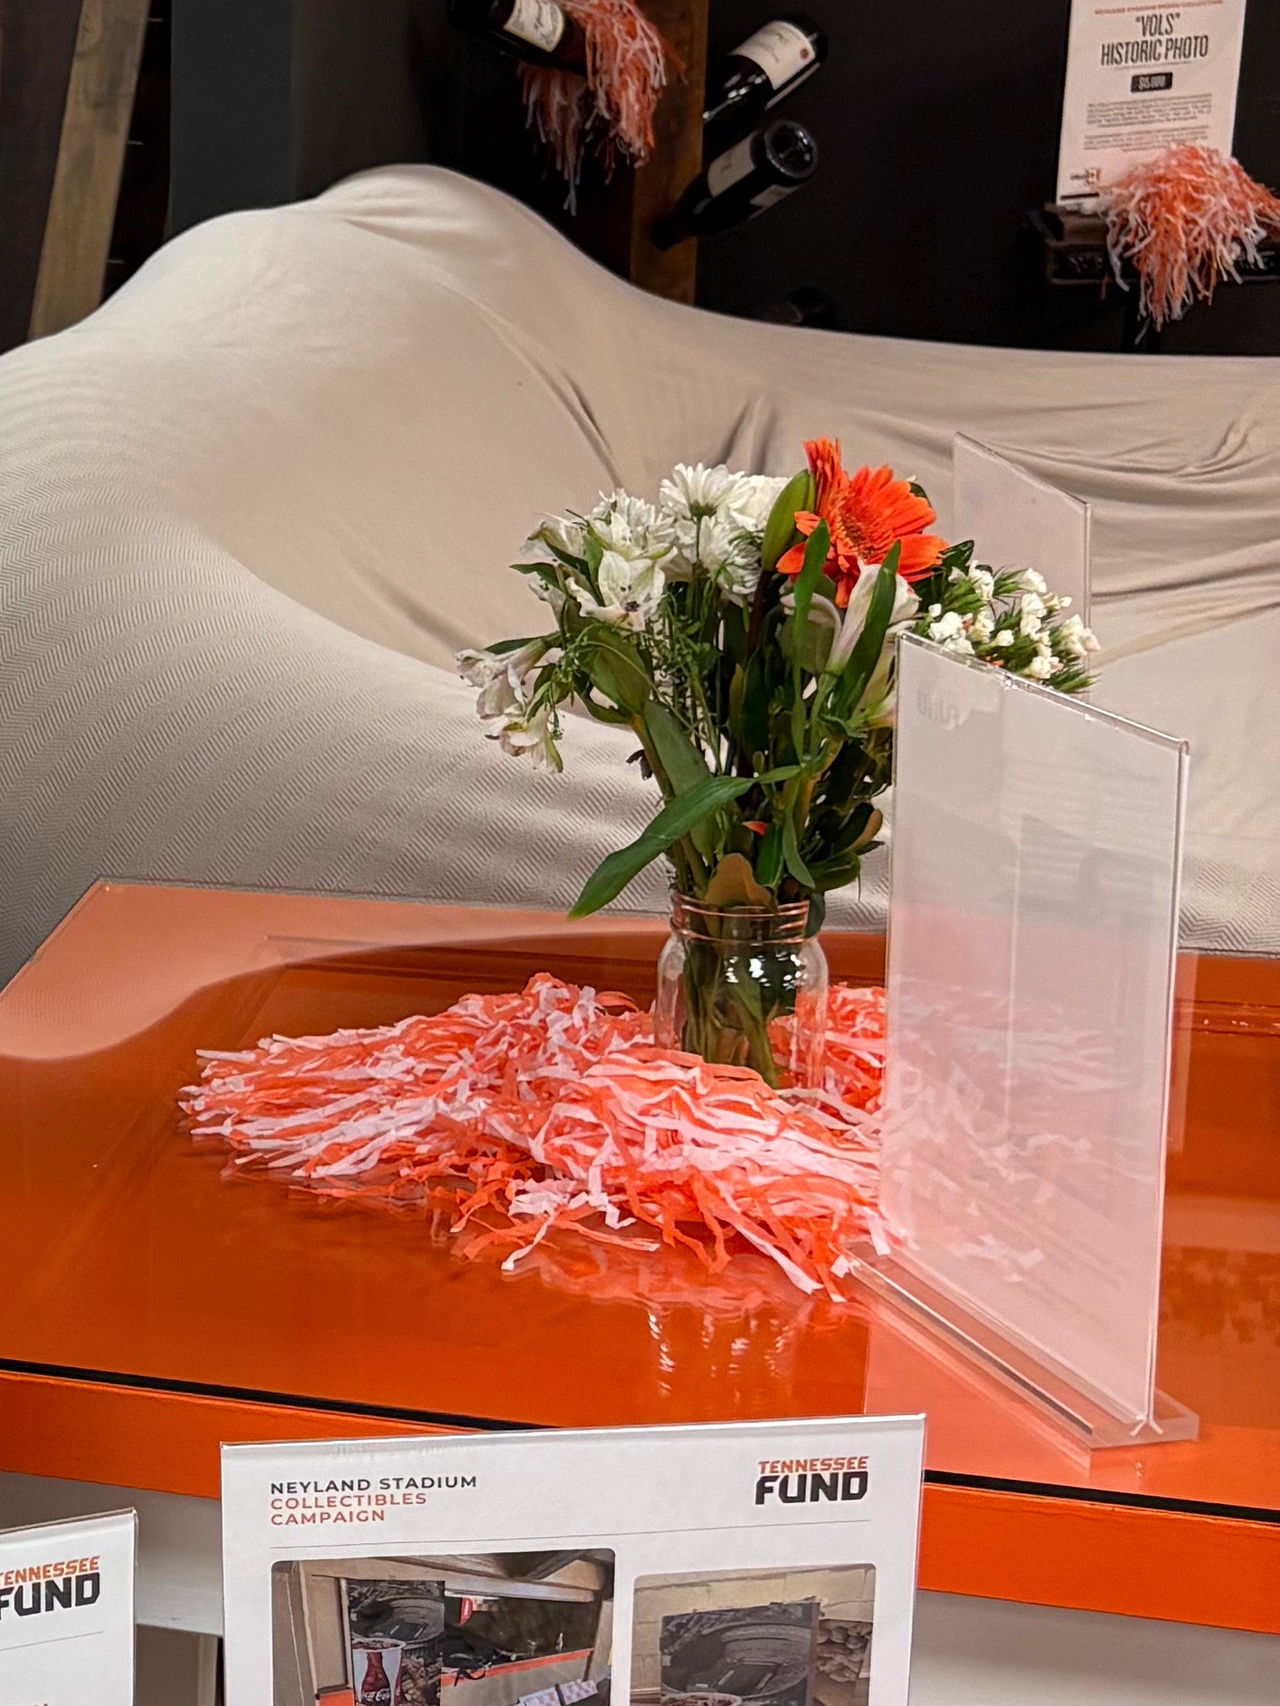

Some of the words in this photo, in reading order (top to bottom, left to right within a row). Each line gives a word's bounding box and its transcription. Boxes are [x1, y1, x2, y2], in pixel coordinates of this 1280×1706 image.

[1100, 38, 1162, 66] HISTORIC
[1164, 34, 1209, 60] PHOTO
[757, 1455, 869, 1474] TENNESSEE
[269, 1478, 372, 1496] NEYLAND
[378, 1475, 478, 1491] STADIUM
[754, 1470, 869, 1505] FUND
[270, 1492, 427, 1511] COLLECTIBLES
[270, 1508, 385, 1527] CAMPAIGN
